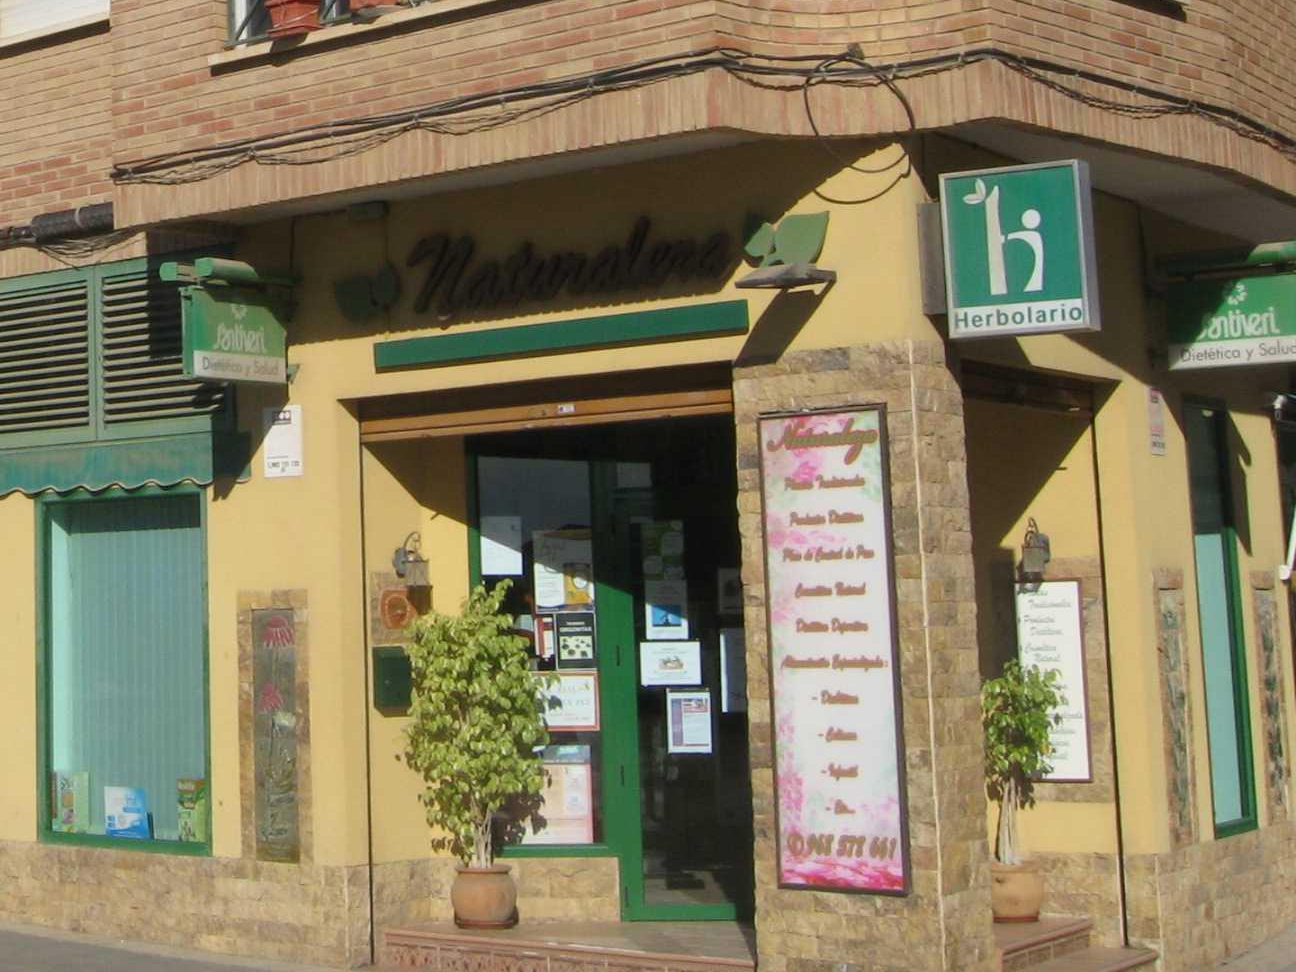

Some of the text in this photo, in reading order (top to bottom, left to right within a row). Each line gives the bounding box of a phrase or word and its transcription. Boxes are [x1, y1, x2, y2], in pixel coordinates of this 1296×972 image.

[954, 303, 1083, 329] Herbolario
[1180, 345, 1242, 363] Dietética
[1246, 348, 1255, 361] y
